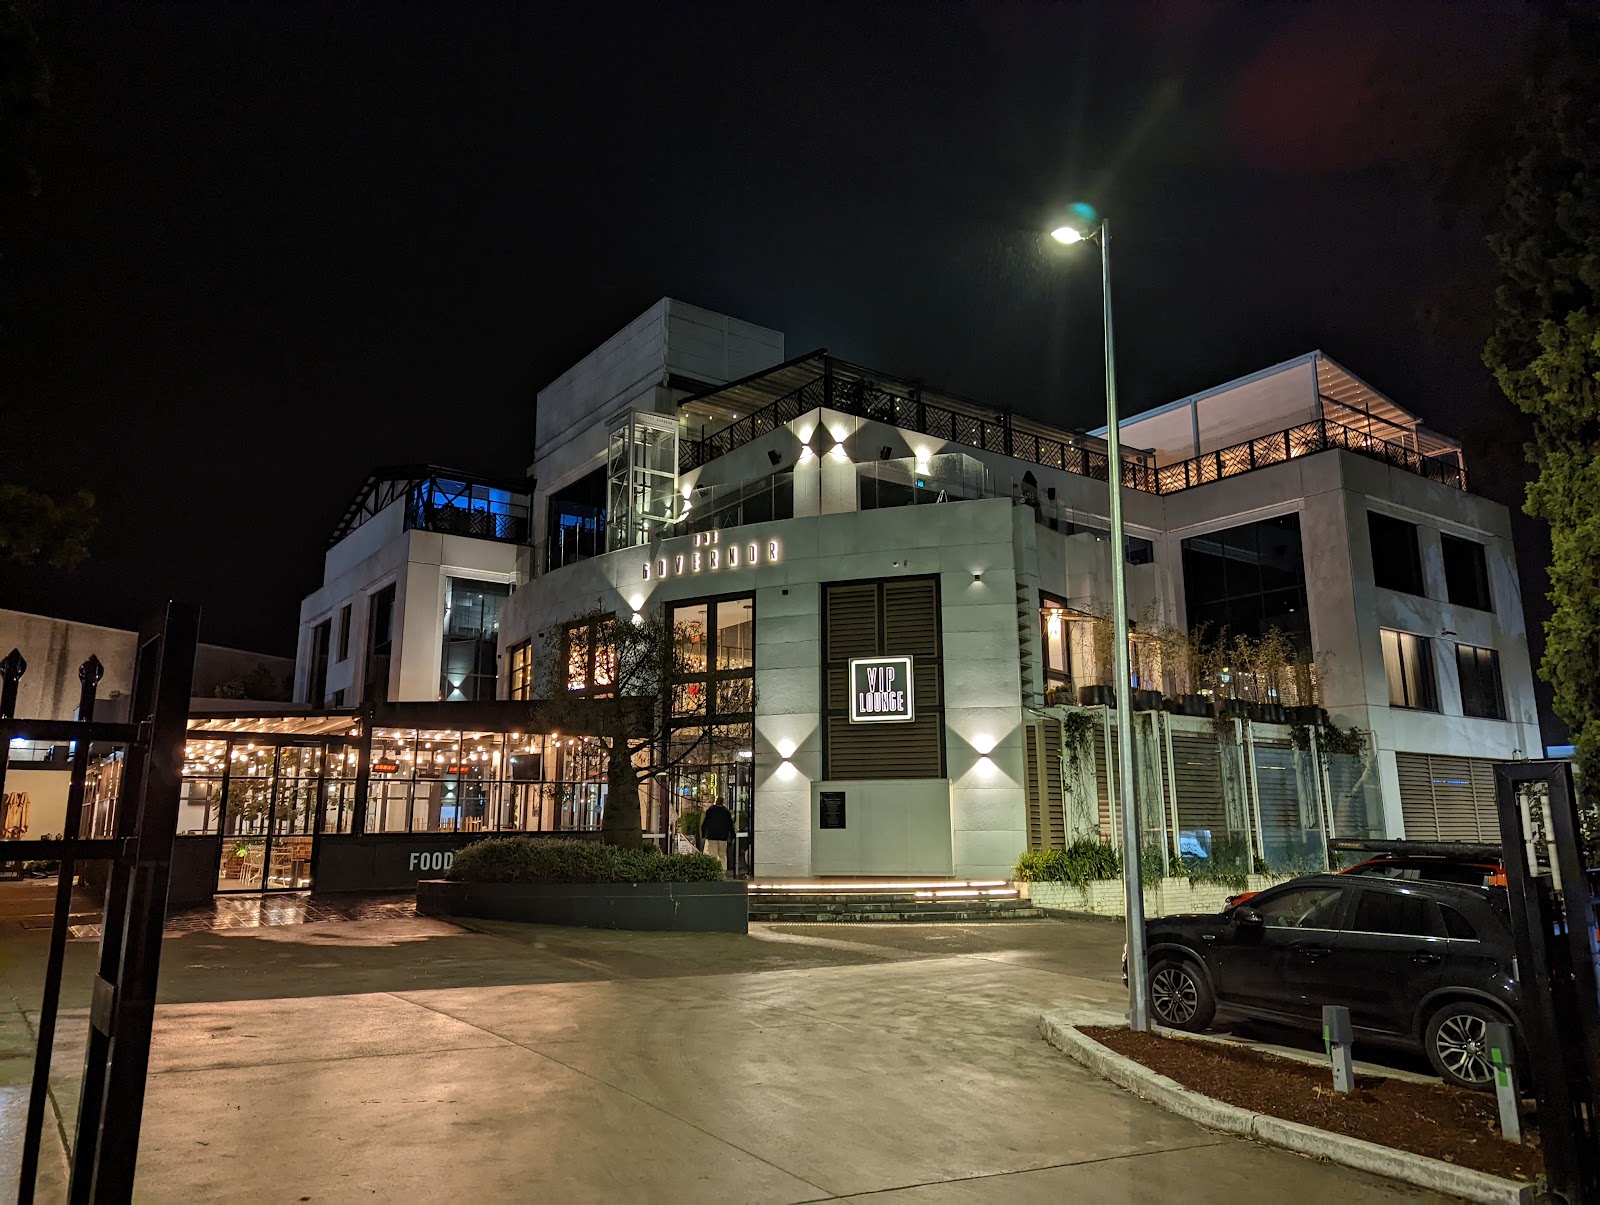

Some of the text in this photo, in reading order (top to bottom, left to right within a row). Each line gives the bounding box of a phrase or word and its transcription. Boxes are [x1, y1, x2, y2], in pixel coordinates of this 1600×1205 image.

[694, 531, 719, 547] THE
[643, 541, 780, 582] GOVERNOR
[866, 666, 896, 693] VIP
[859, 690, 904, 713] LOUNGE
[409, 851, 454, 871] FOOD
